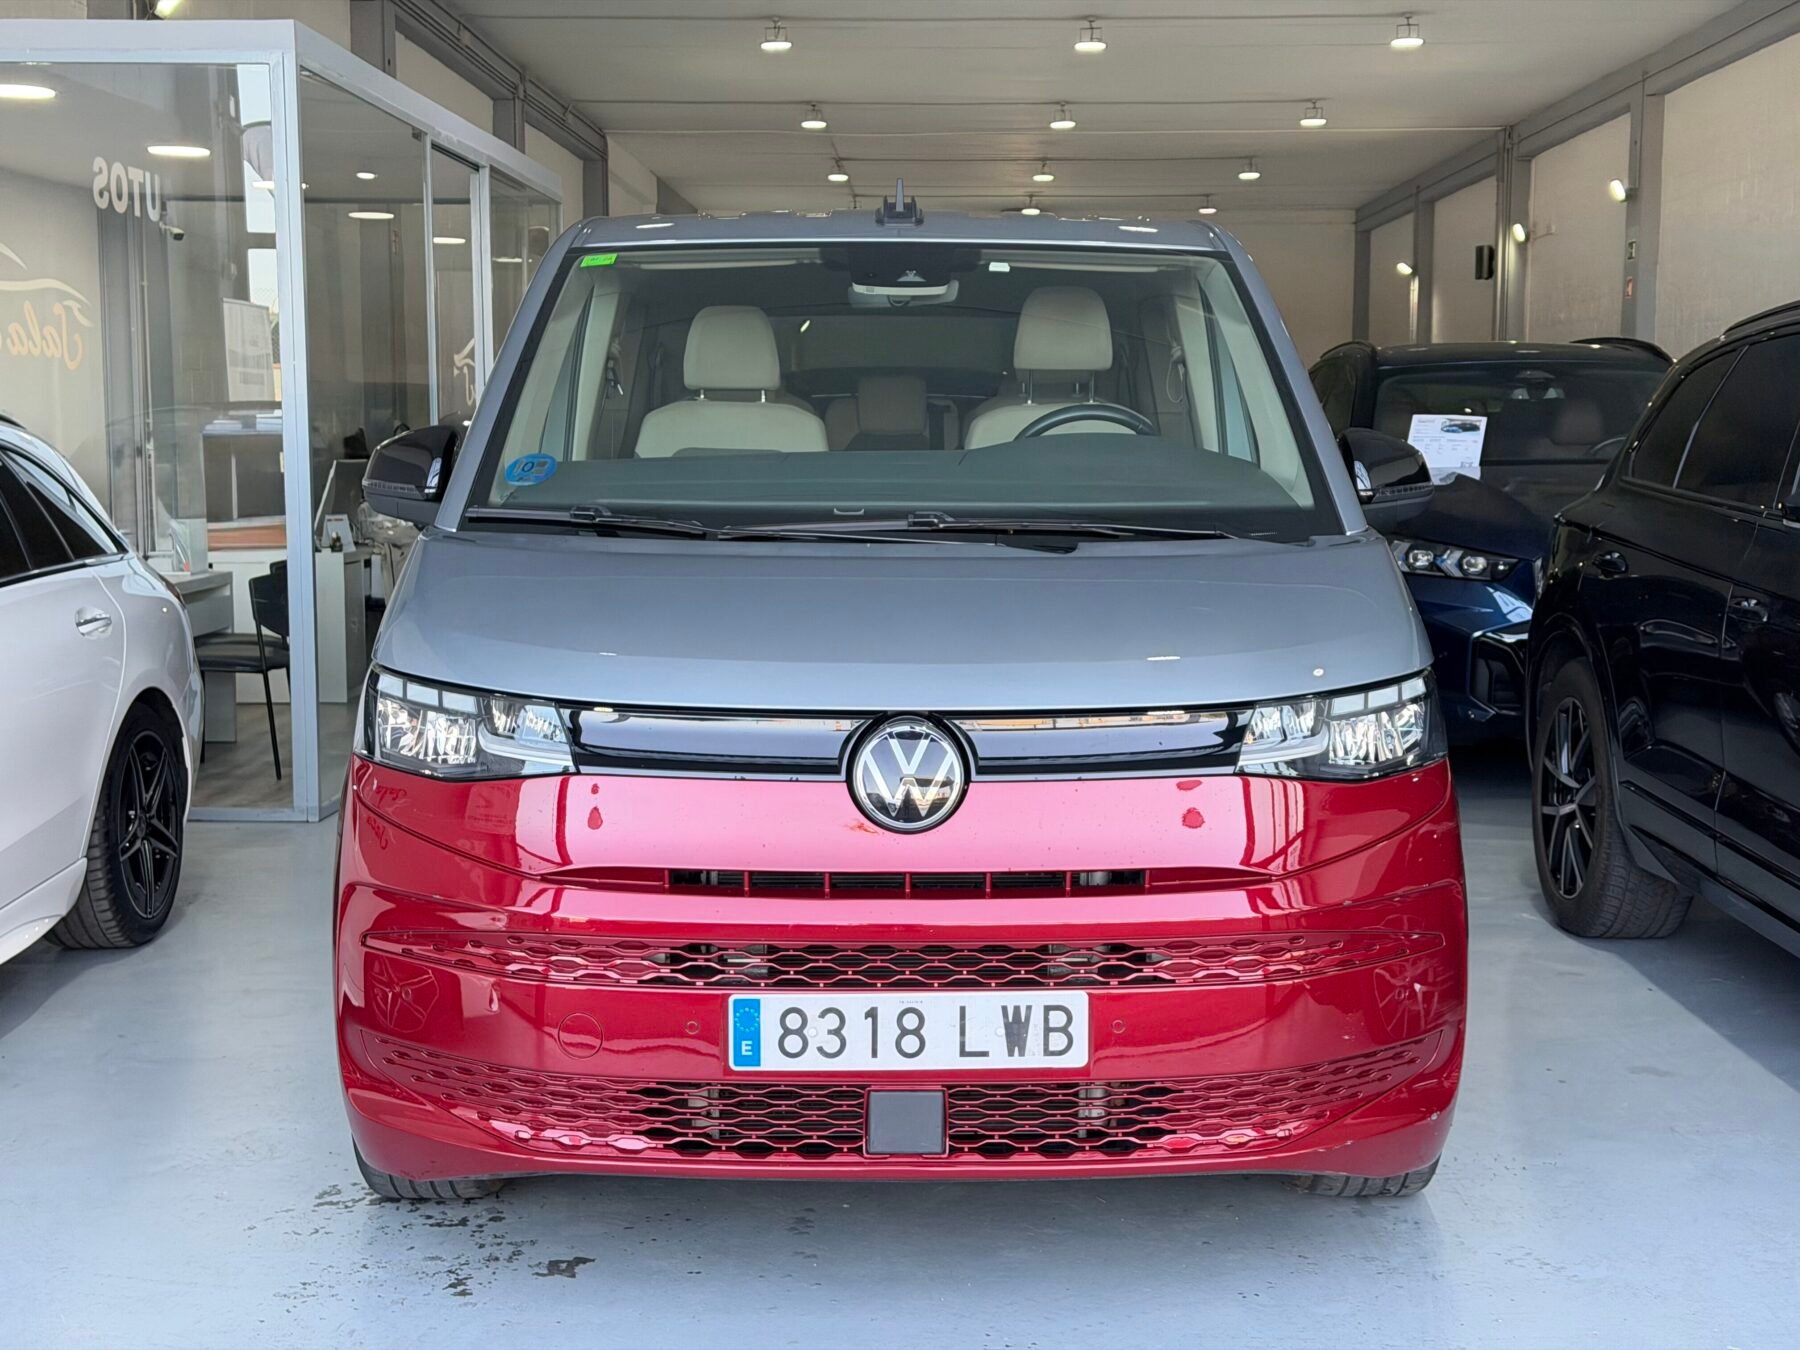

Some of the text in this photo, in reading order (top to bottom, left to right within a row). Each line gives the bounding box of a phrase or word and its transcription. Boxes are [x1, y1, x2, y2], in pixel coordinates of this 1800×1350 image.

[741, 1040, 752, 1055] E
[778, 1004, 1074, 1059] 8318 LWB
